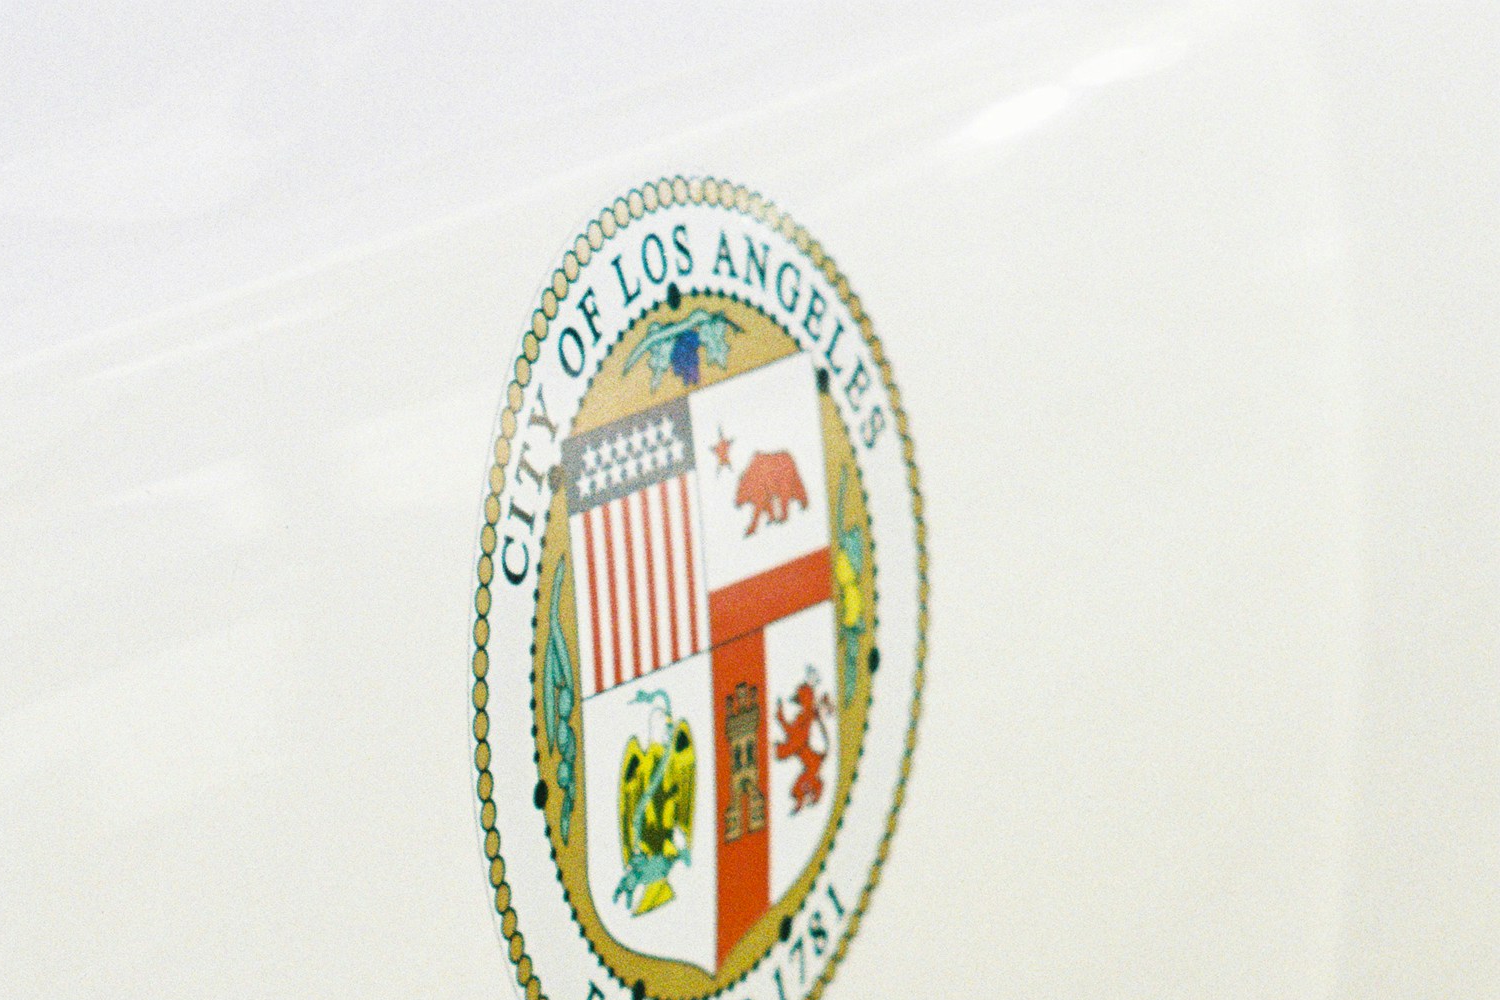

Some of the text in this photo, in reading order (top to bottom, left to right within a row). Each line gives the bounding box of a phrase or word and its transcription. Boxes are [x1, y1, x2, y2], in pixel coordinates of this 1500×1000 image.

[501, 224, 887, 585] CITY OF LOS ANGELES
